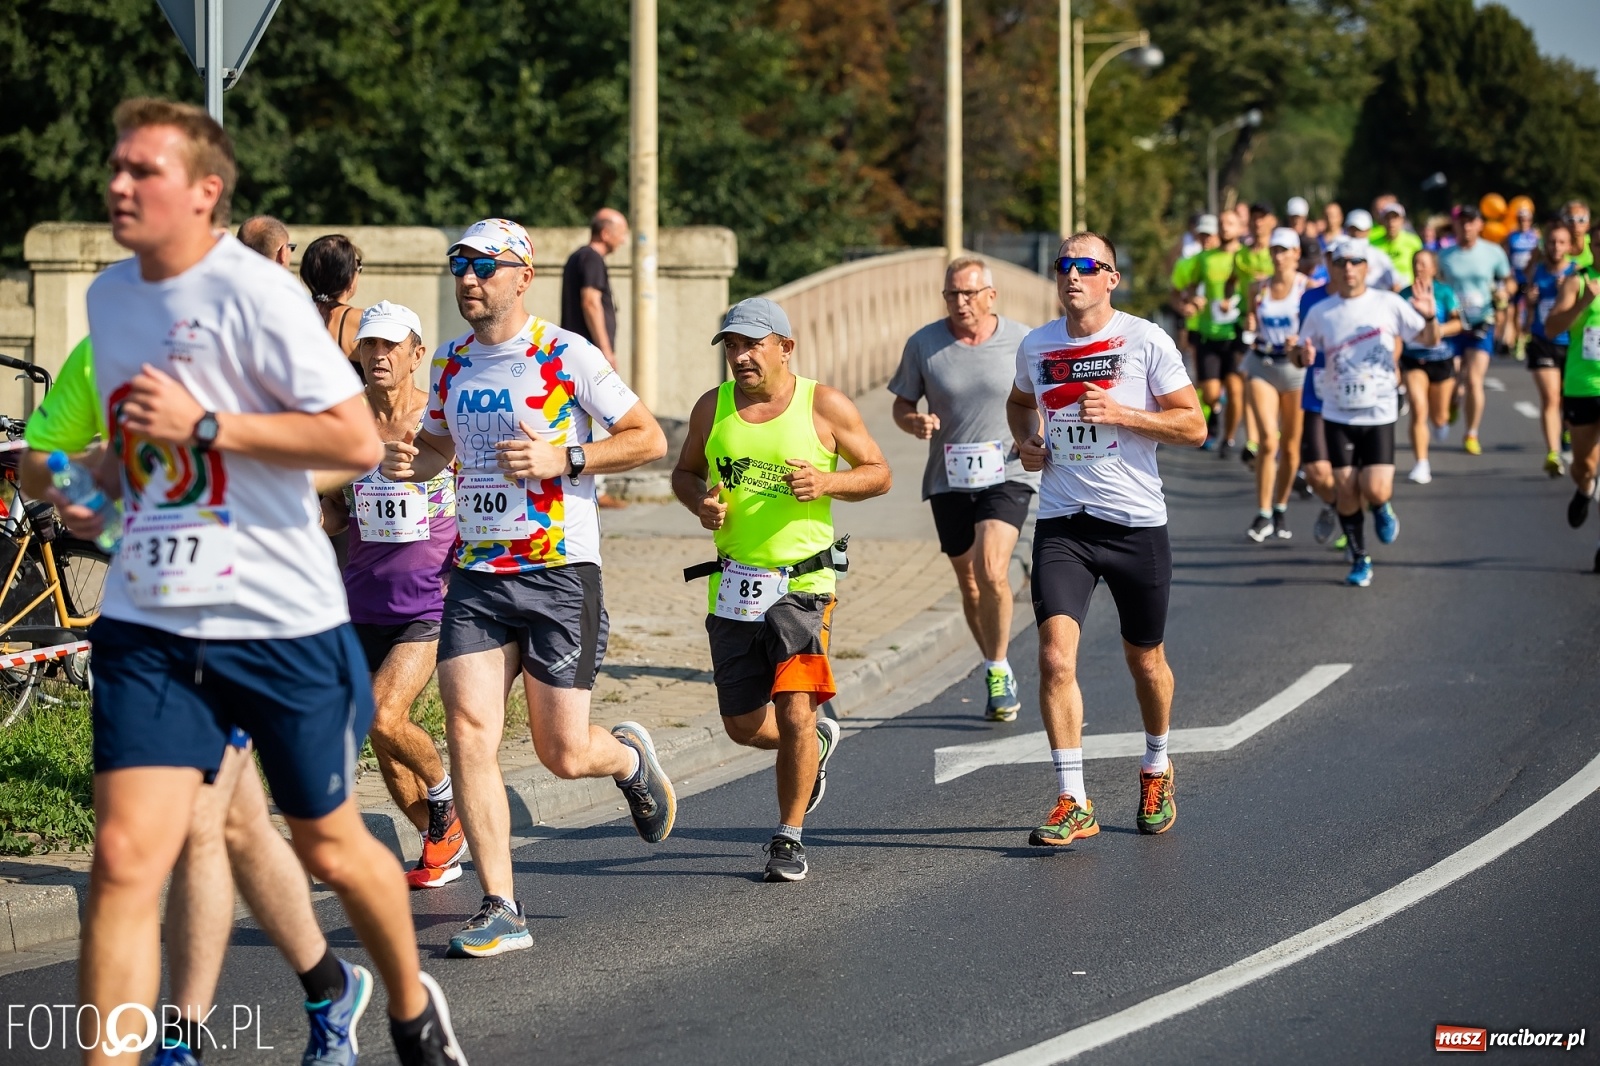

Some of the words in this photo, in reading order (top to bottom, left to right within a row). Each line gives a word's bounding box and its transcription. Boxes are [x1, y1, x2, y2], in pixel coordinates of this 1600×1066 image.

[1071, 369, 1112, 379] TRIATHLON
[1072, 359, 1112, 372] OSIEK
[457, 389, 513, 413] NOA
[457, 413, 514, 432] RUN
[1067, 425, 1097, 443] 171
[462, 449, 513, 470] LIF
[966, 455, 983, 469] 71
[376, 499, 407, 519] 181
[473, 492, 508, 514] 260
[148, 536, 200, 568] 377
[739, 579, 763, 599] 85
